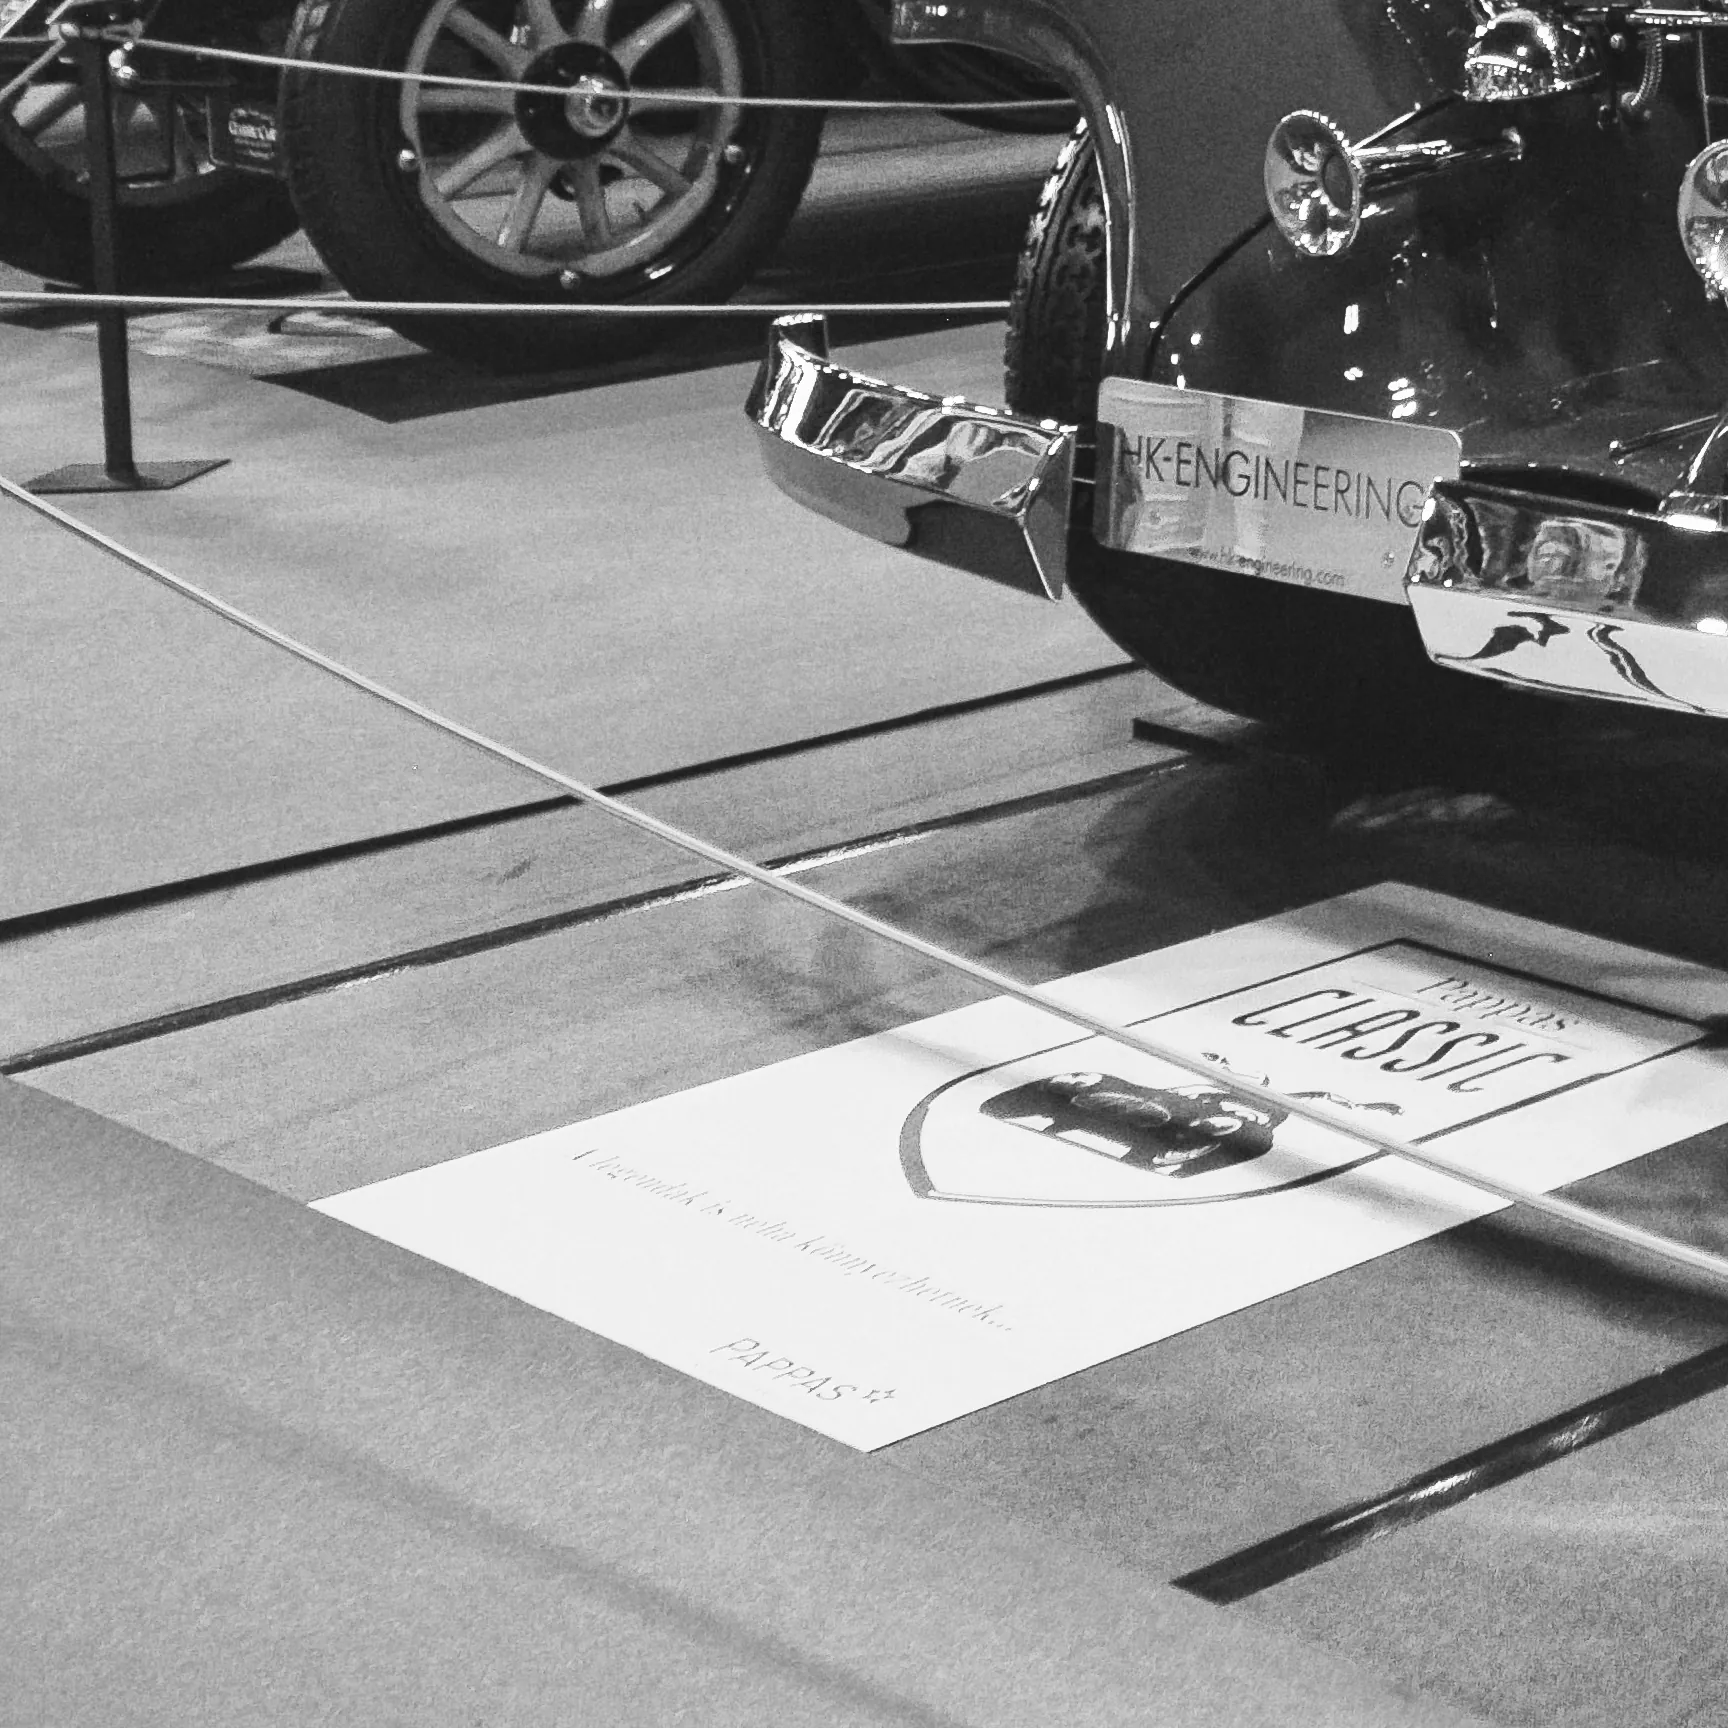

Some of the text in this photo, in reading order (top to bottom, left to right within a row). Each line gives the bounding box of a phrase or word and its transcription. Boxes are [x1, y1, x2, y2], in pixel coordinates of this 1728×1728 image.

[1118, 434, 1427, 528] HK-ENGINEERING
[1231, 988, 1573, 1094] CLASSIC
[709, 1337, 860, 1401] PAPPAS
